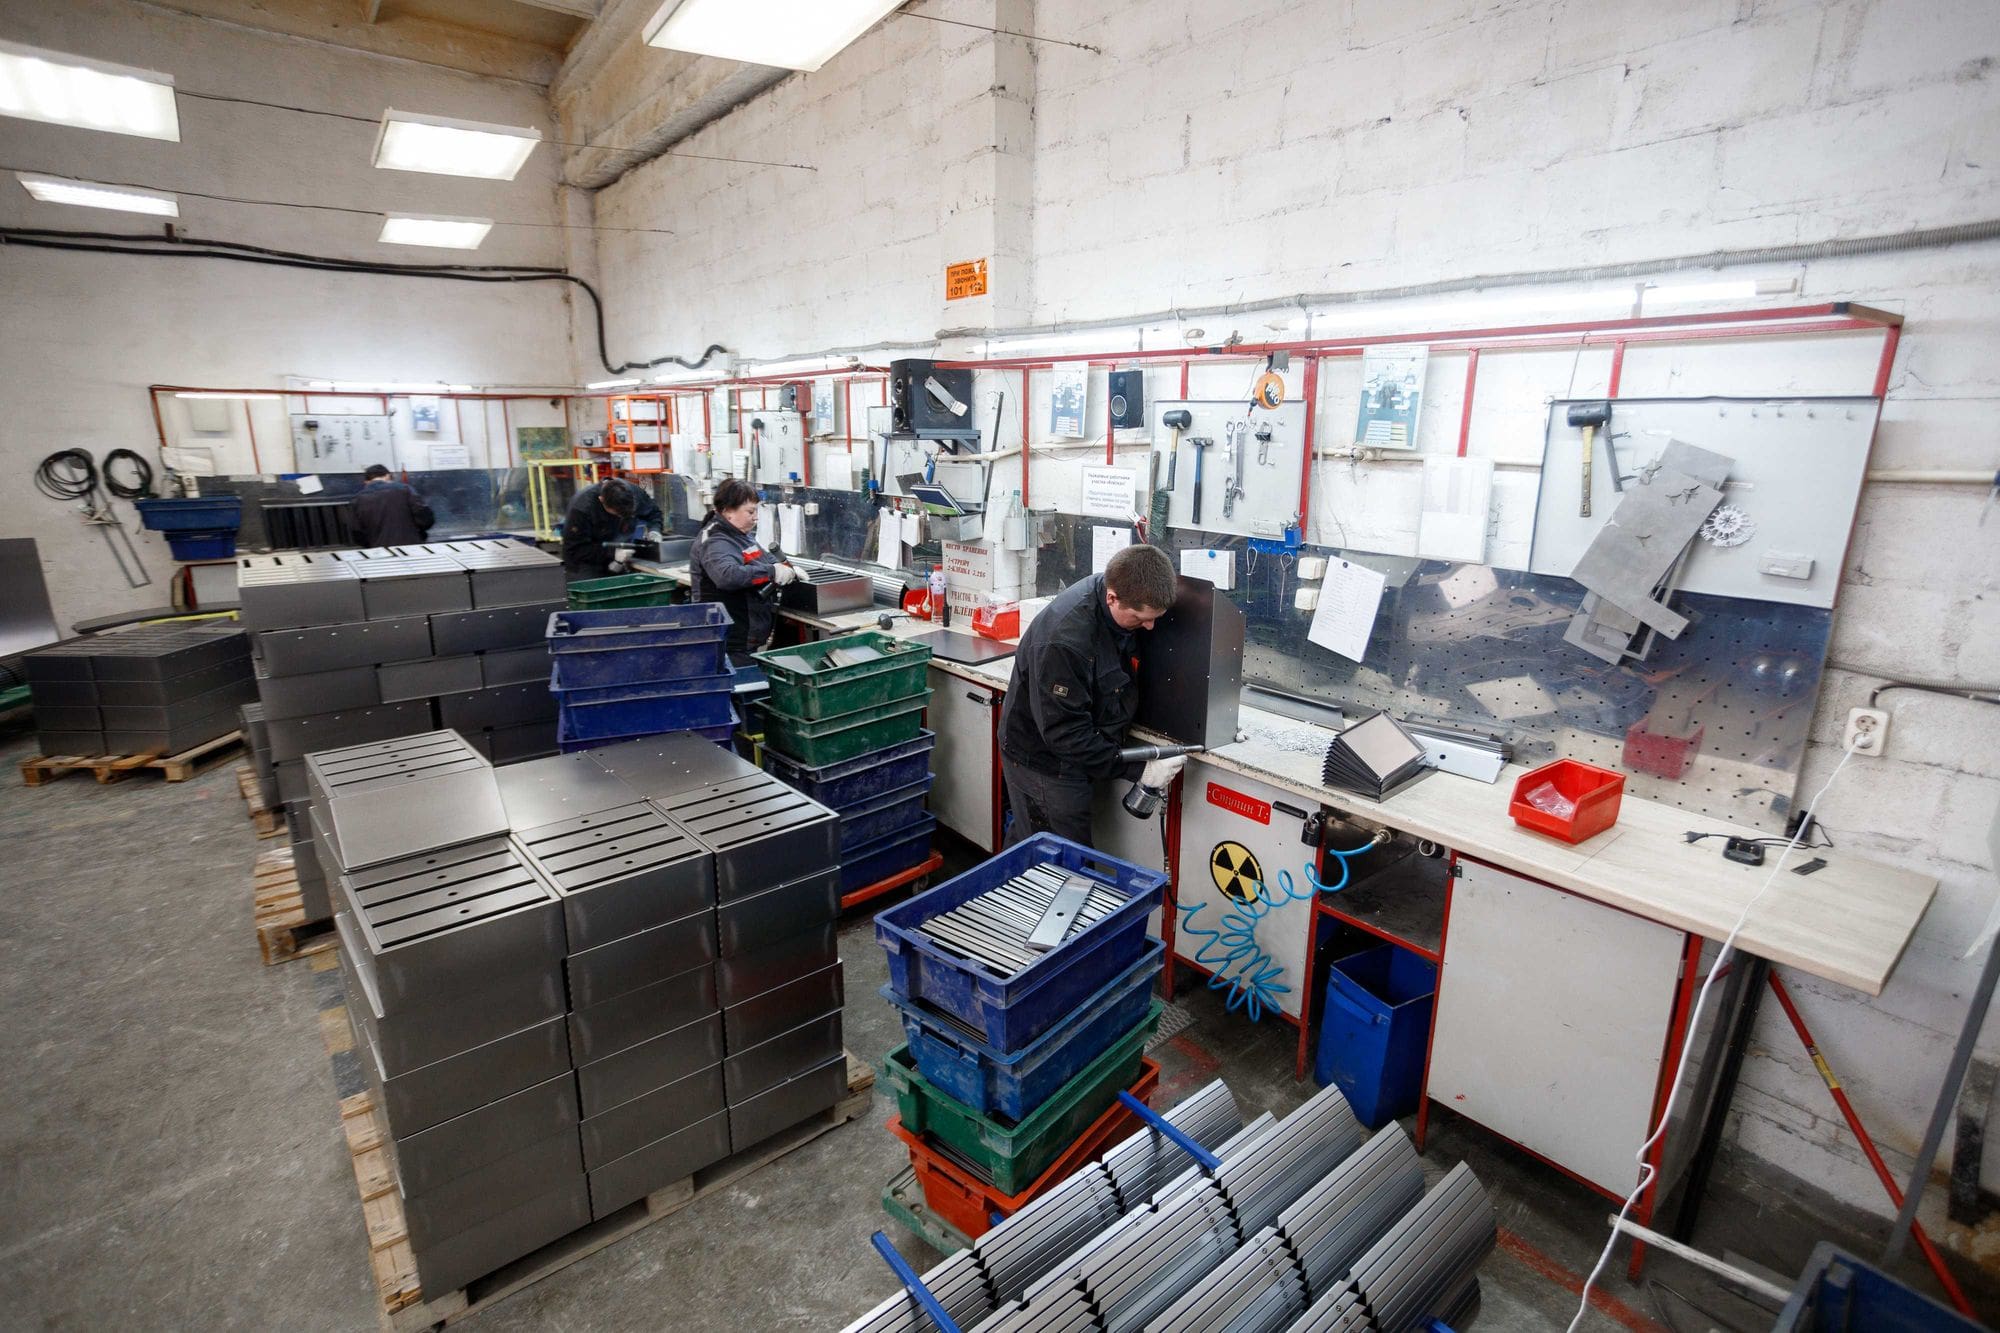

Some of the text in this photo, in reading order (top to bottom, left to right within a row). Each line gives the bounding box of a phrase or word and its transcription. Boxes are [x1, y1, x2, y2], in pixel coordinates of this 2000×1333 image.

[950, 285, 963, 296] 101
[962, 545, 988, 555] ХРАНЕНИЯ
[951, 591, 971, 602] УЧАСТОК
